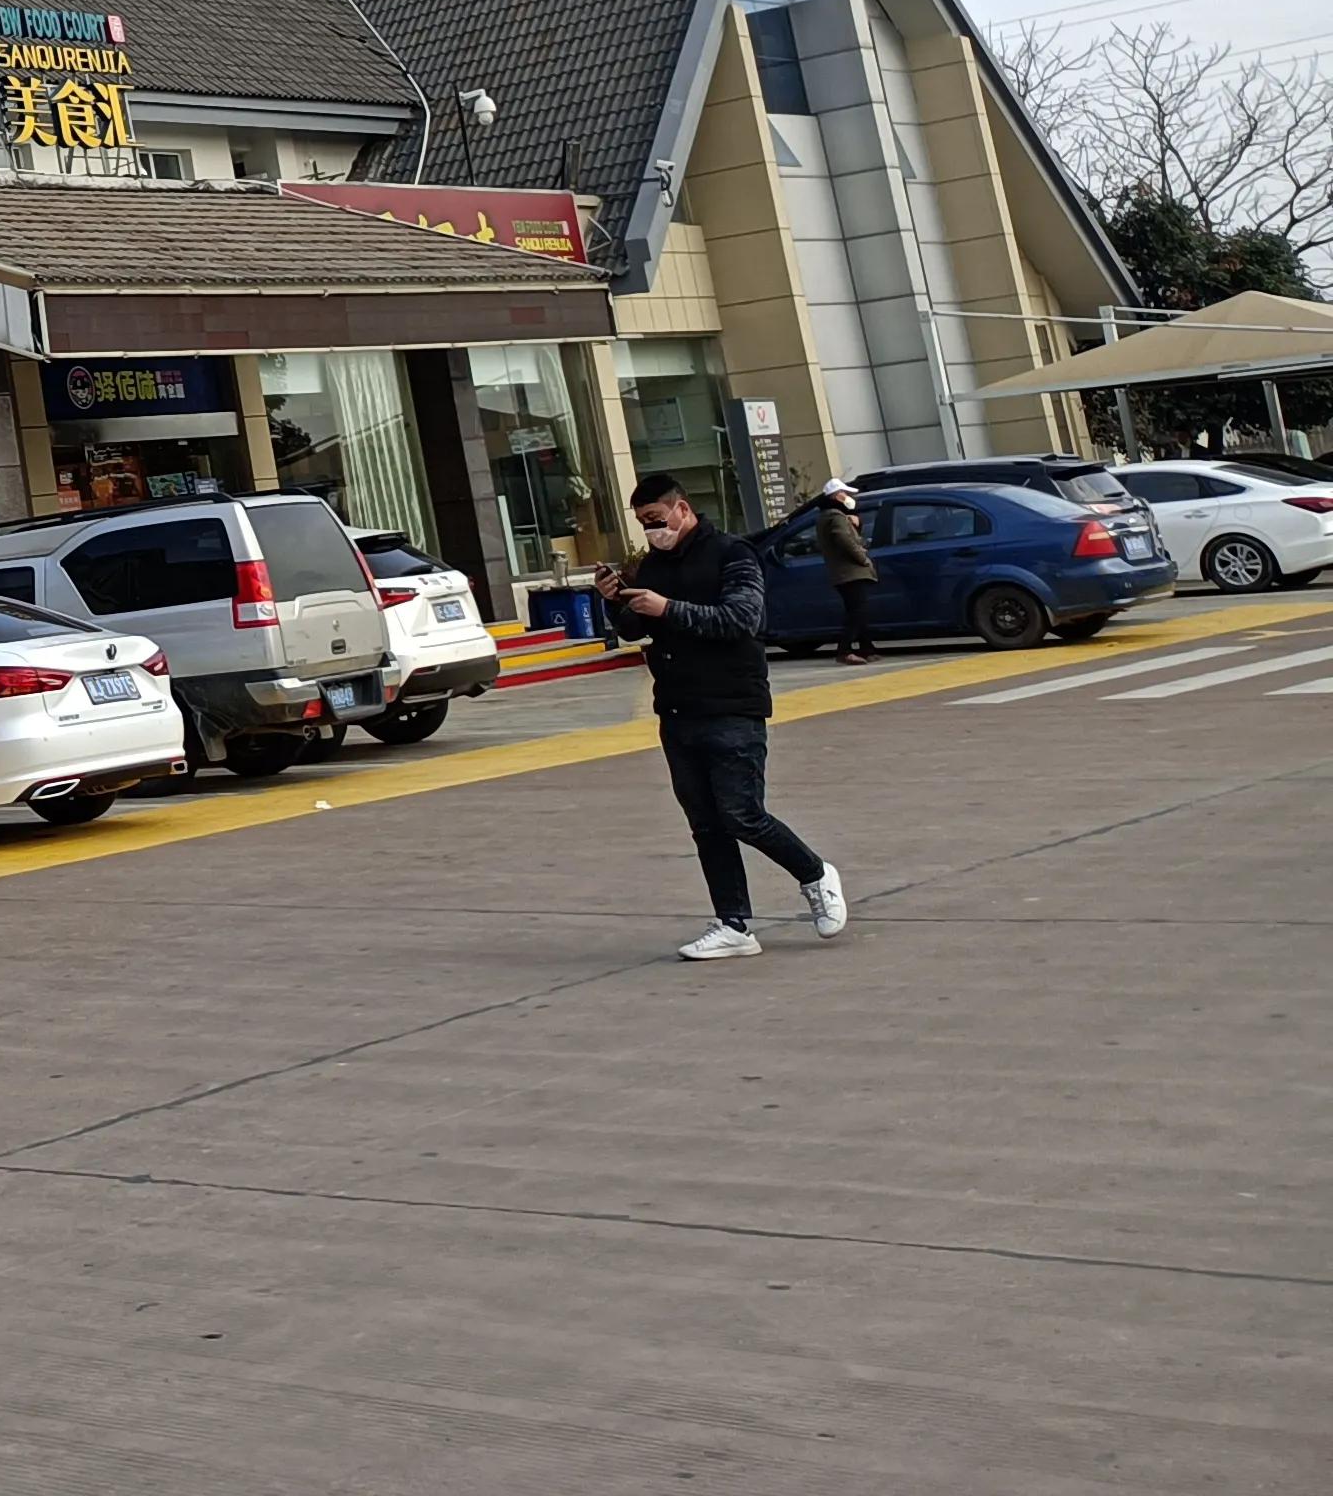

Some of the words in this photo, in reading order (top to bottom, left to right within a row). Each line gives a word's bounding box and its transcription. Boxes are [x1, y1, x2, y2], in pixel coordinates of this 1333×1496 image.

[23, 8, 62, 39] FOOD
[62, 11, 106, 42] COURT
[3, 75, 145, 148] 美食汇
